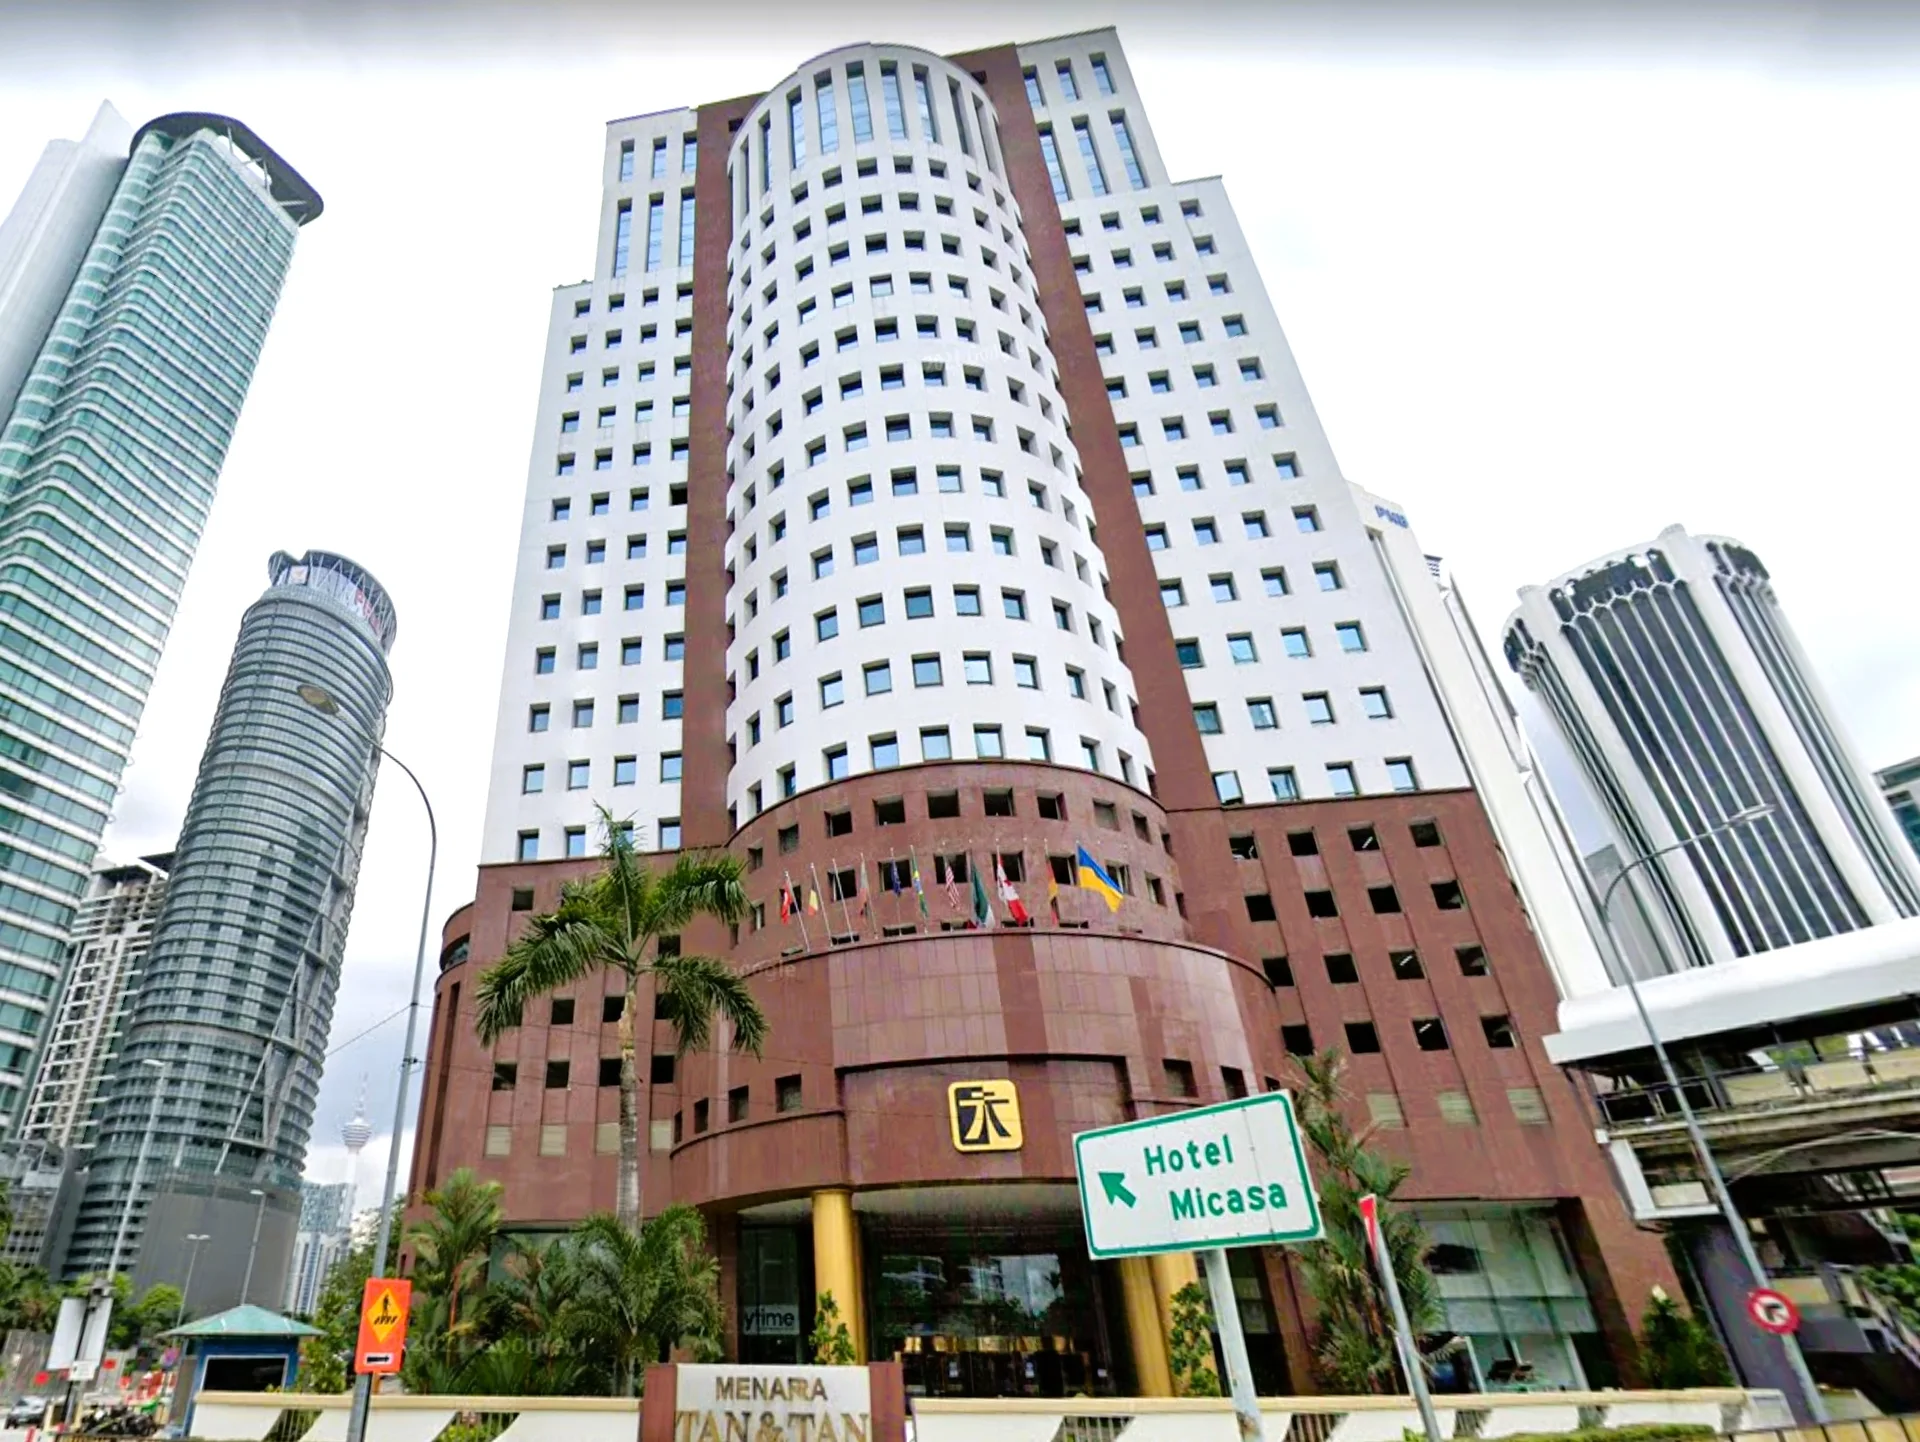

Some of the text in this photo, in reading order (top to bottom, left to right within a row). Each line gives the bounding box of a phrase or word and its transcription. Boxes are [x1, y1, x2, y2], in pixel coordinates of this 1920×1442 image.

[1143, 1133, 1234, 1177] Hotel
[1169, 1182, 1288, 1222] Micasa
[715, 1376, 828, 1401] MENARA
